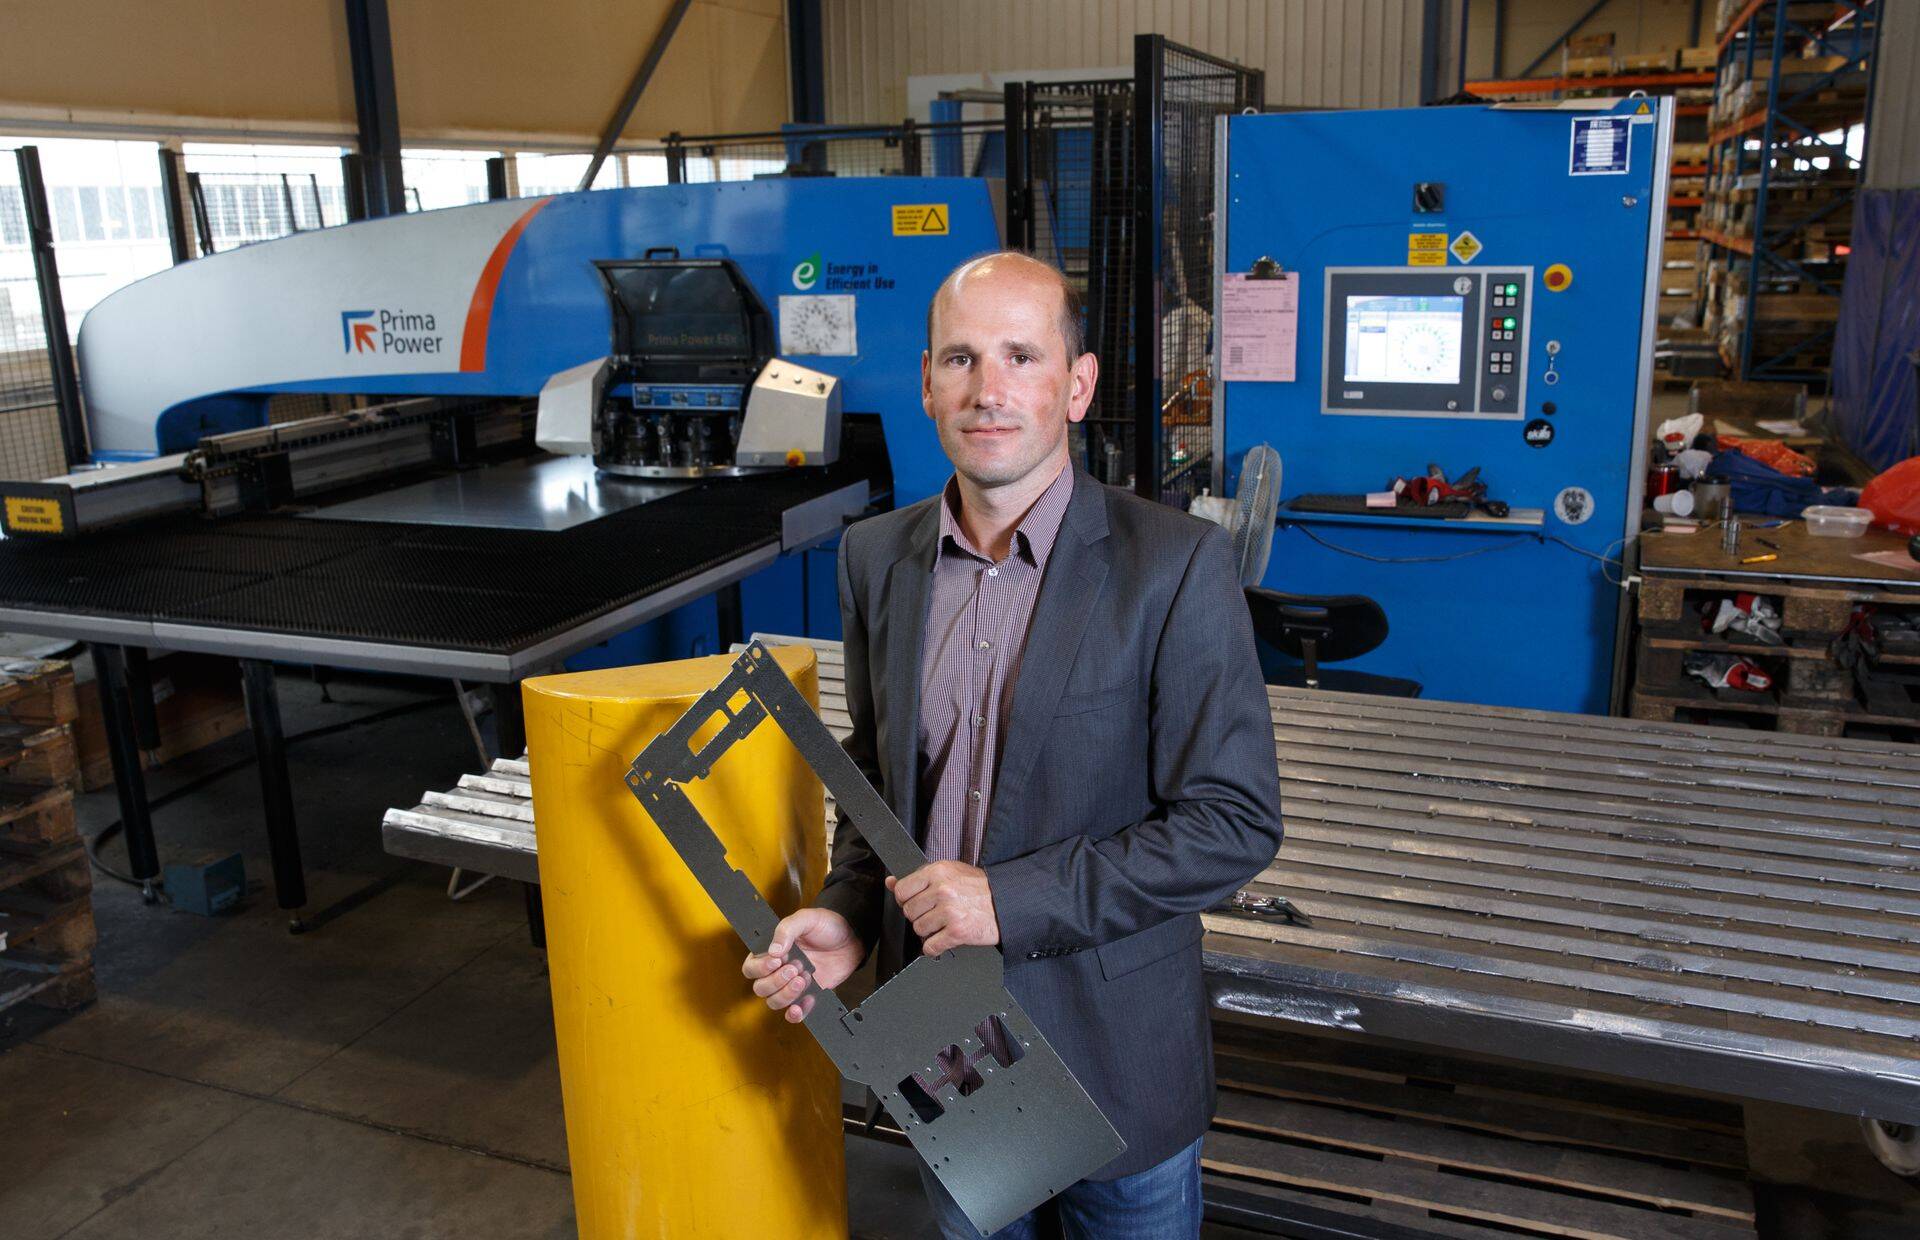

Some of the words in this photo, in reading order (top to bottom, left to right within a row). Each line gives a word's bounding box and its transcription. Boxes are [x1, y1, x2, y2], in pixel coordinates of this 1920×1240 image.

[827, 262, 865, 277] Energy
[867, 262, 878, 274] in
[826, 278, 871, 290] Efficient
[874, 277, 895, 290] Use
[380, 309, 435, 331] Prima
[383, 332, 443, 354] Power
